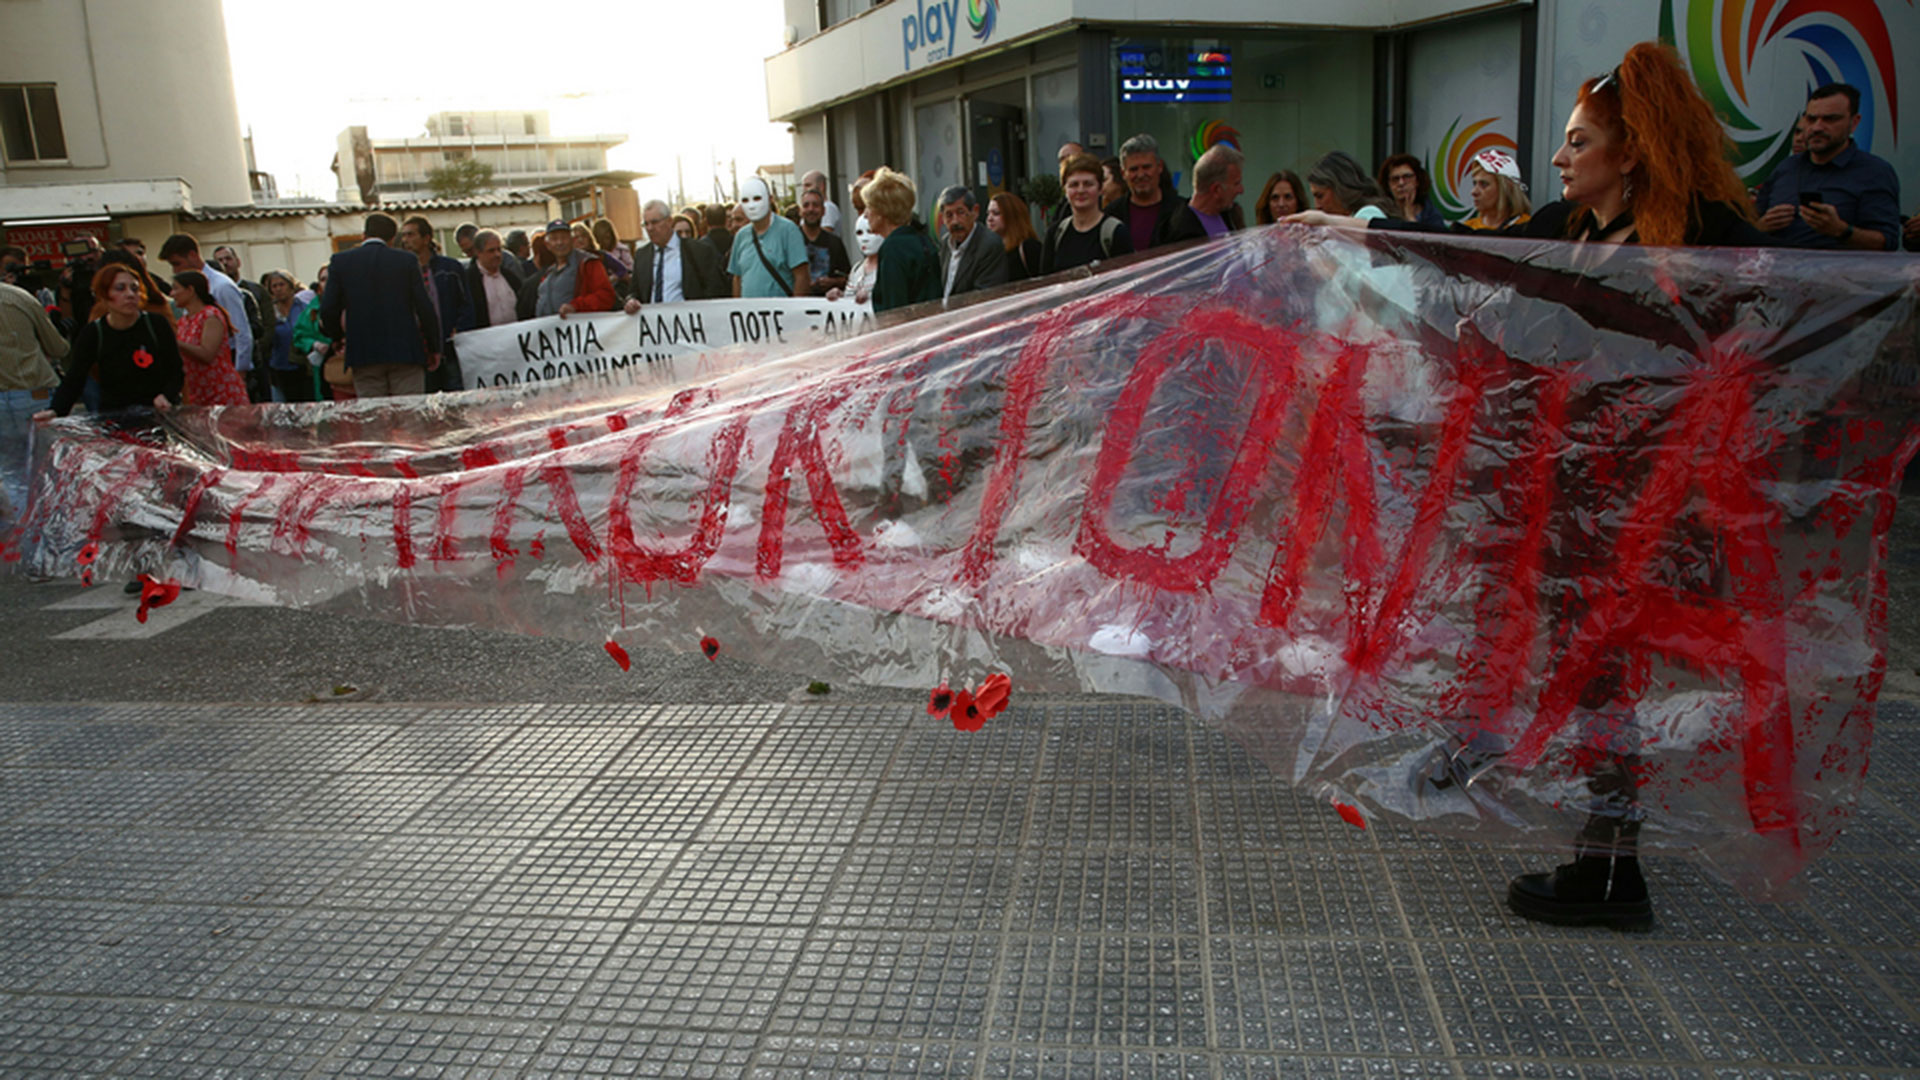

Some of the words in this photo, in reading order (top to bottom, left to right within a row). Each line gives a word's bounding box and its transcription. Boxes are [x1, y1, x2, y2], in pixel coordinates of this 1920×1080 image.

[902, 0, 959, 70] play
[517, 321, 604, 363] ΚΑΜΙΑ
[639, 312, 706, 347] ΑΛΛΗ
[729, 311, 787, 343] ΠΟΤΕ
